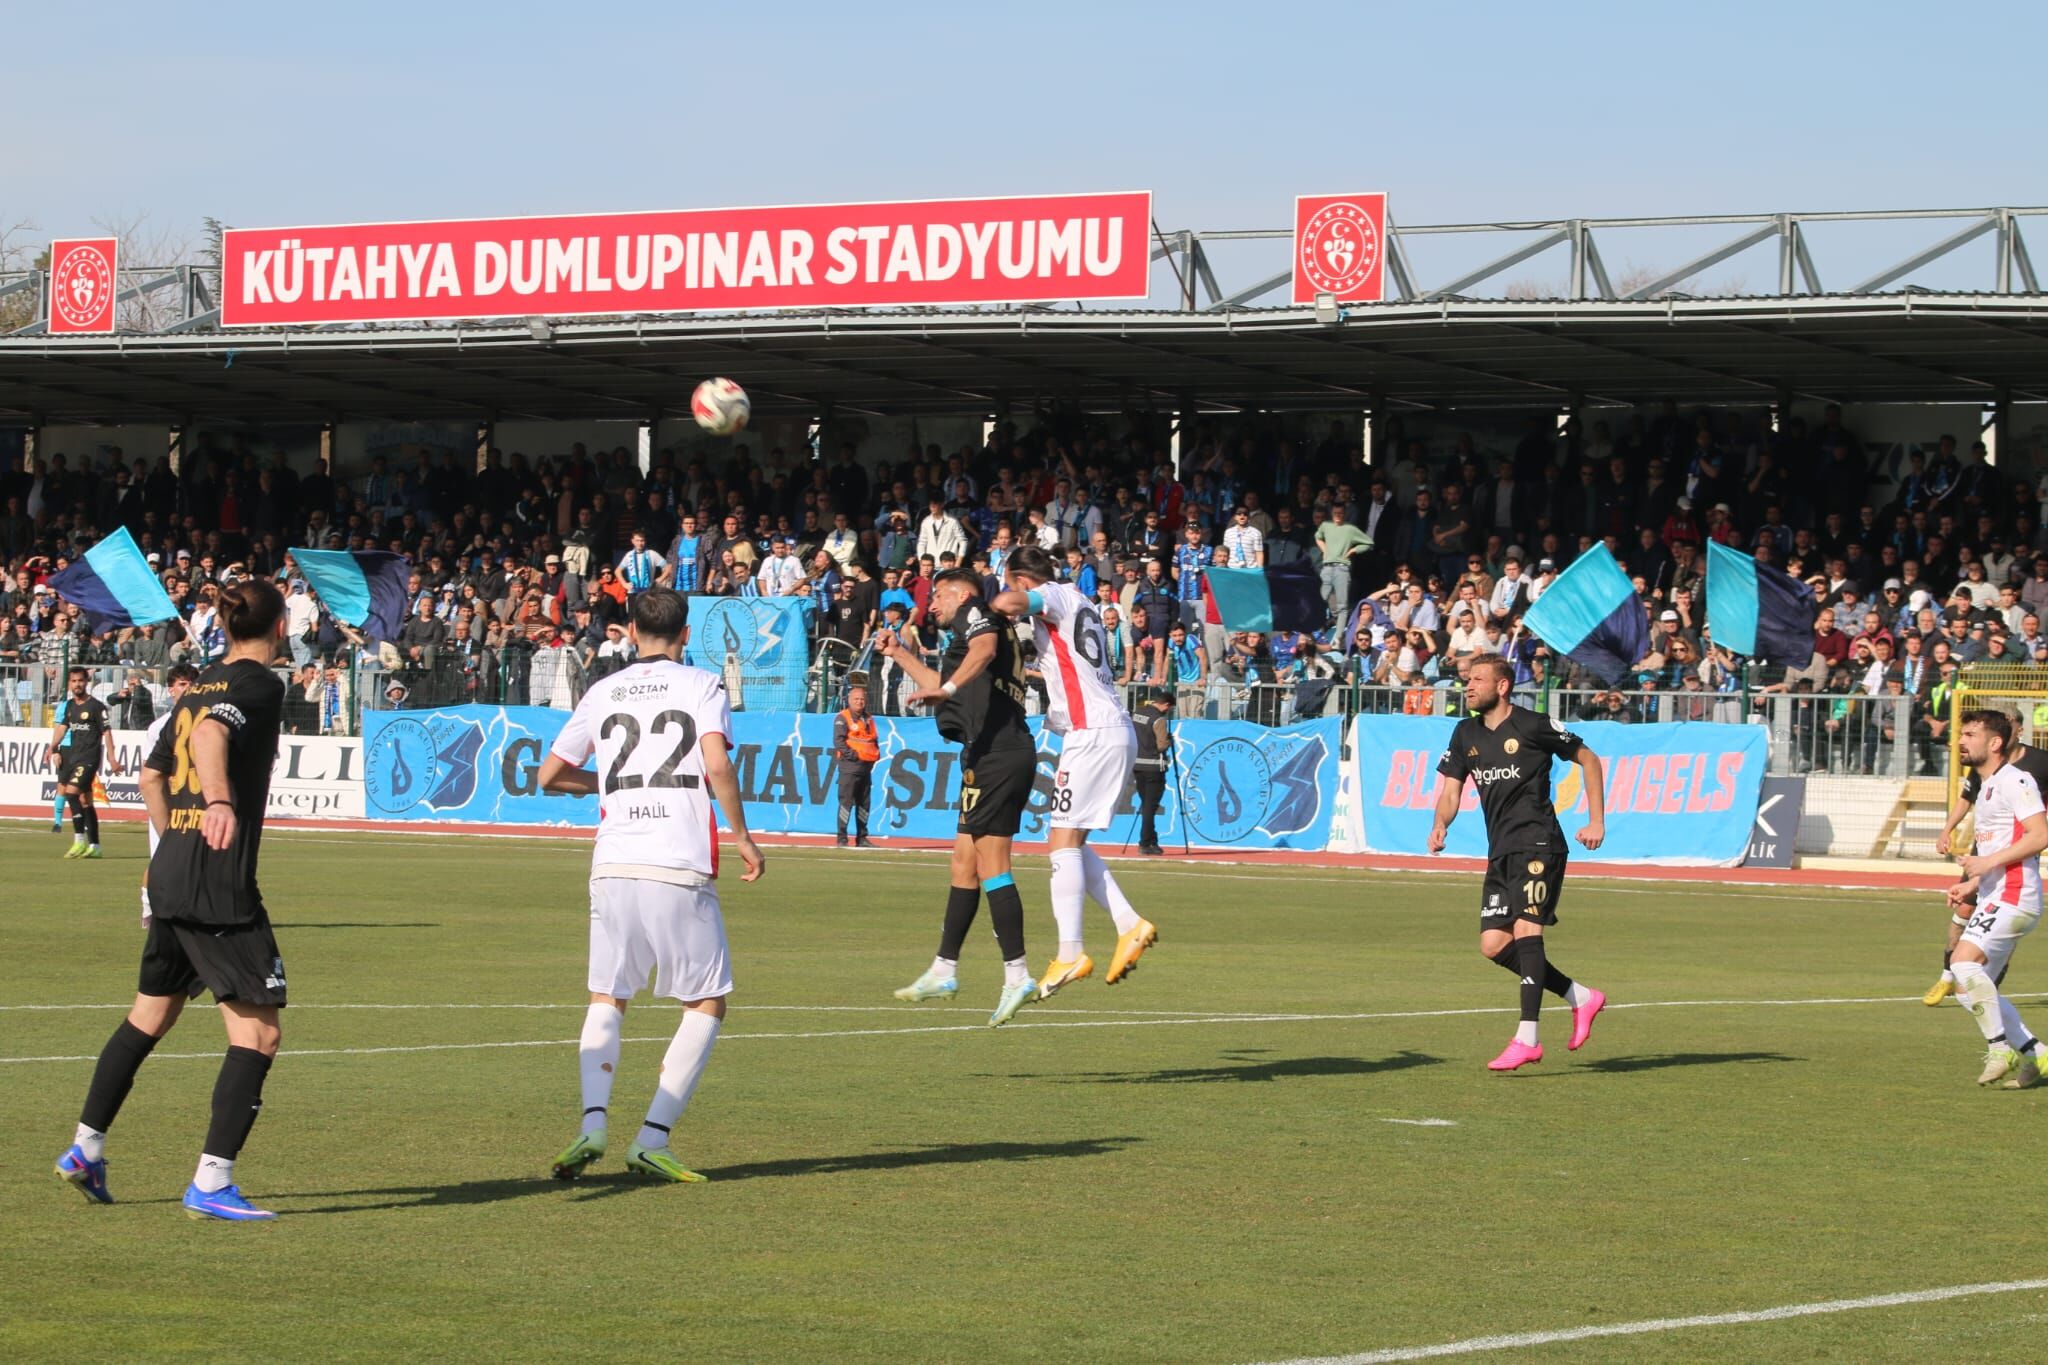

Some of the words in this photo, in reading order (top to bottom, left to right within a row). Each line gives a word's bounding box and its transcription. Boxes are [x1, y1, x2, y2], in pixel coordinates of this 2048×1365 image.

[243, 239, 462, 304] KÜTAHYA
[474, 229, 814, 297] DUMLUPINAR
[824, 216, 1124, 285] STADYUMU
[629, 683, 669, 695] ÖZTAN
[211, 702, 247, 725] ASTRO
[600, 709, 700, 796] 22
[74, 766, 85, 778] 3
[629, 801, 671, 820] HALİL
[961, 787, 981, 813] 17
[1051, 787, 1073, 814] 68
[1522, 880, 1548, 905] 10
[1969, 912, 1997, 934] 64
